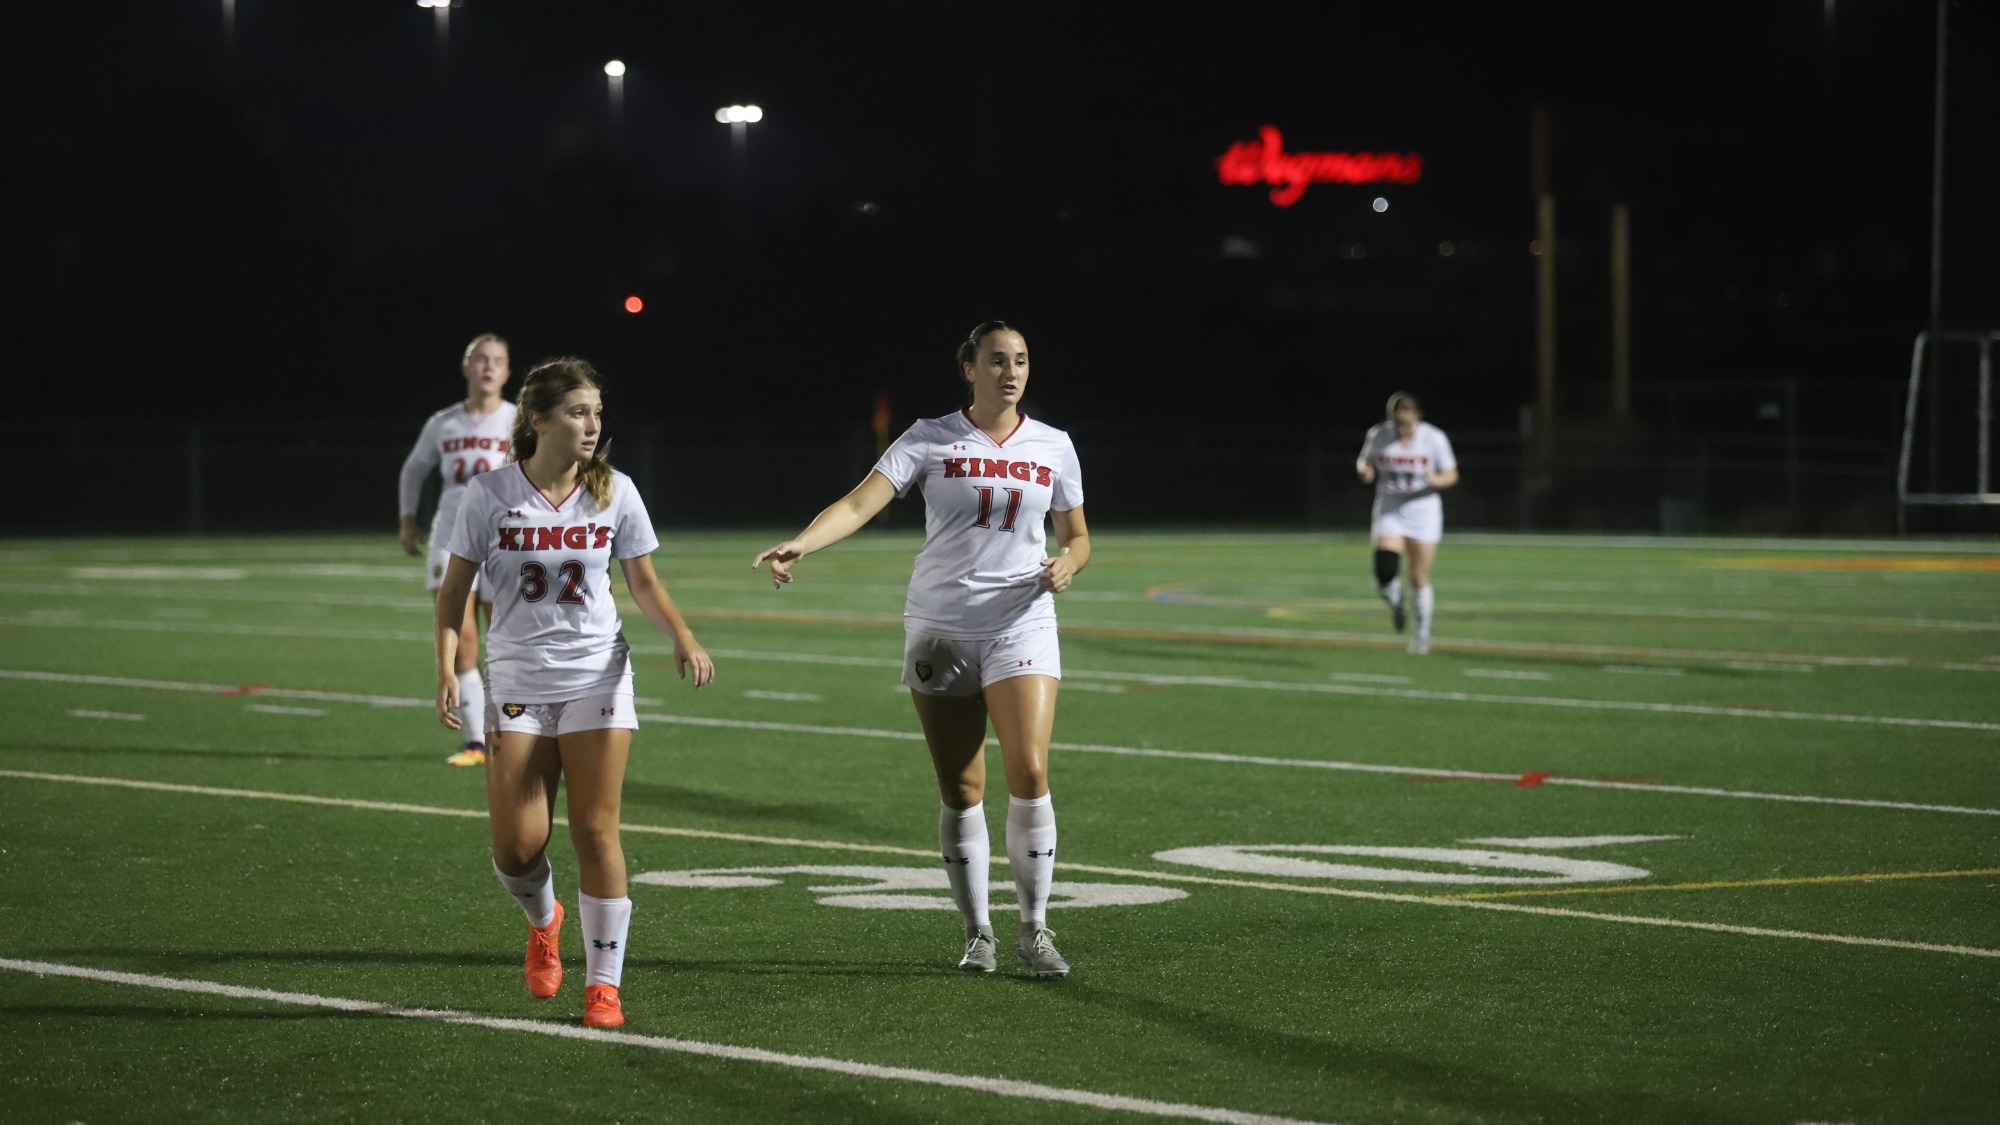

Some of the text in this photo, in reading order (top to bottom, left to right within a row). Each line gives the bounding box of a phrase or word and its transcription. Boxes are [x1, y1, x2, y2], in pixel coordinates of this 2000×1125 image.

[943, 457, 1052, 488] KING'S
[972, 485, 1023, 533] 11
[498, 523, 612, 551] KING'S
[521, 560, 588, 605] 32
